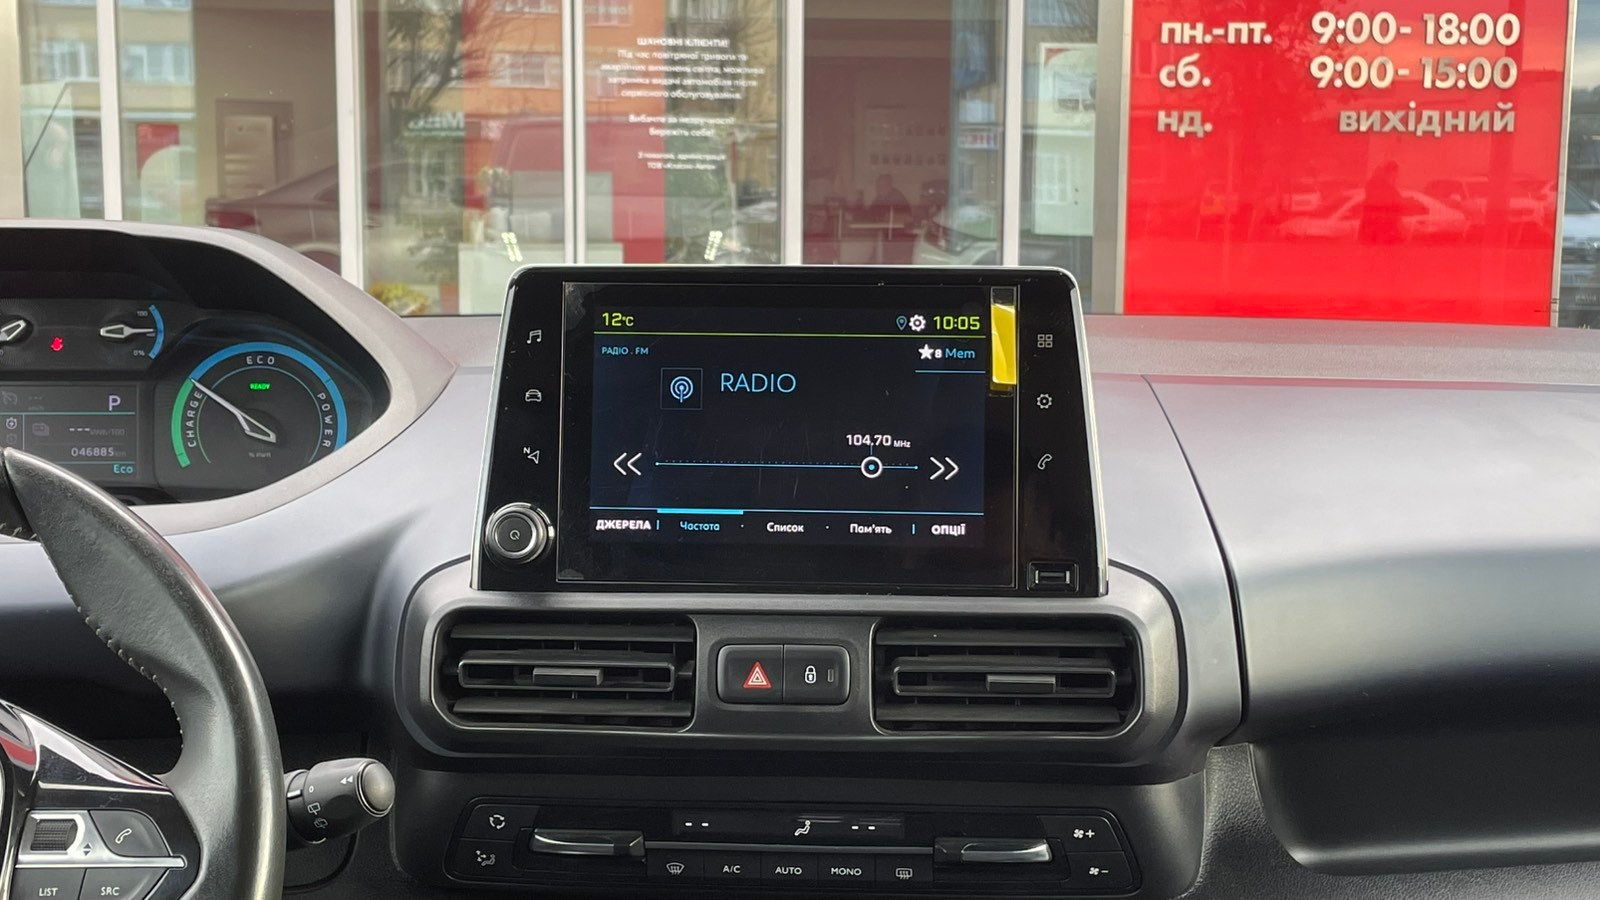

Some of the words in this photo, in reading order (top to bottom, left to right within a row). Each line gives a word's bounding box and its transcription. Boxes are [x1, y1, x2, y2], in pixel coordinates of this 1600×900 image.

[1421, 12, 1521, 47] 18:00
[1158, 53, 1212, 88] сб.
[1420, 56, 1519, 90] 15:00
[1157, 110, 1213, 137] нд.
[1339, 101, 1515, 138] вихідний
[933, 316, 981, 330] 10:05
[601, 346, 629, 356] РАДІО
[635, 347, 649, 355] FM
[934, 349, 942, 359] 8
[945, 348, 976, 359] Mem
[246, 355, 275, 365] ECO
[720, 372, 797, 393] RADIO
[108, 395, 121, 411] P
[185, 390, 203, 448] CHARGE
[317, 392, 333, 448] POWER
[845, 434, 892, 446] 104.70
[893, 439, 911, 448] MHz
[71, 447, 114, 457] 046885
[113, 464, 134, 474] Eco
[595, 519, 652, 531] ДЖЕРЕЛА
[680, 521, 720, 531] Частота
[766, 521, 805, 533] Список
[931, 523, 966, 536] ОПЦІЇ
[722, 864, 741, 874] A/C
[774, 866, 803, 875] AUTO
[830, 867, 862, 876] MONO
[38, 887, 58, 897] LIST
[100, 886, 120, 896] SRC
